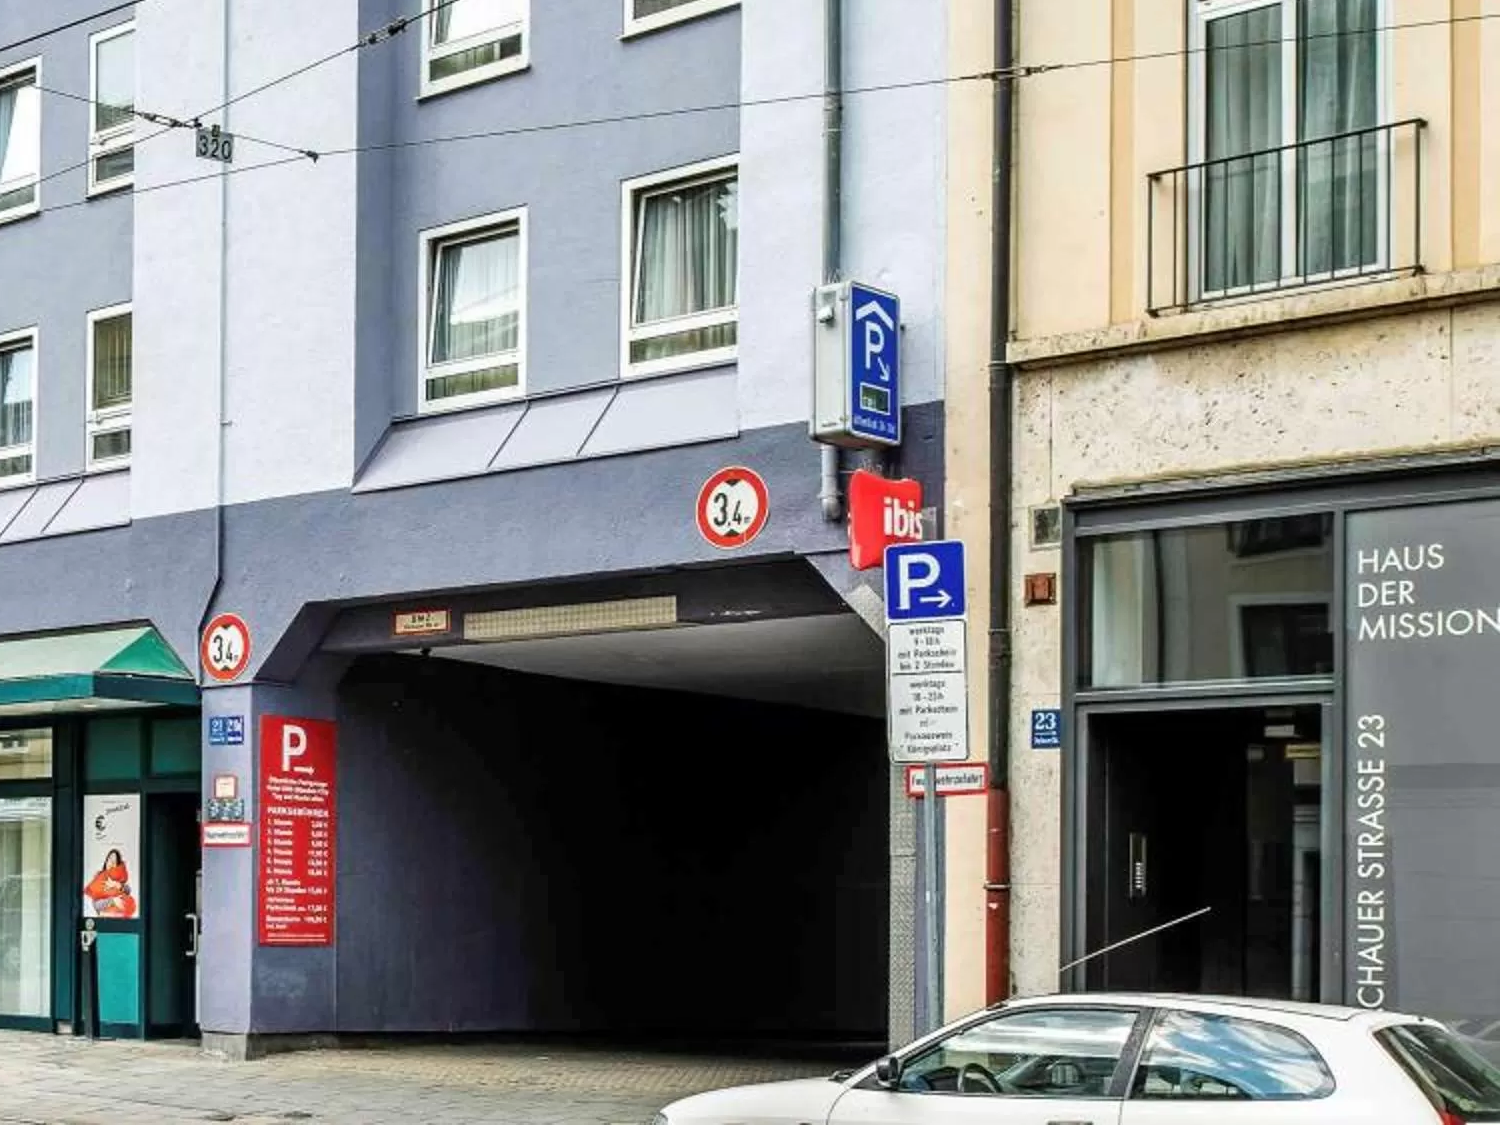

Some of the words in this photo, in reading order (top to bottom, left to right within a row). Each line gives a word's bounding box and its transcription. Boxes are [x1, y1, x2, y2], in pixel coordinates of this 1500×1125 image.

[199, 135, 232, 160] 320
[883, 496, 923, 540] ibis
[1358, 542, 1445, 574] HAUS
[896, 553, 941, 610] P
[1358, 580, 1415, 608] DER
[1358, 607, 1500, 642] MISSION
[1035, 712, 1057, 730] 23
[1357, 714, 1386, 748] 23
[282, 724, 307, 772] P
[1357, 759, 1386, 879] STRASSE
